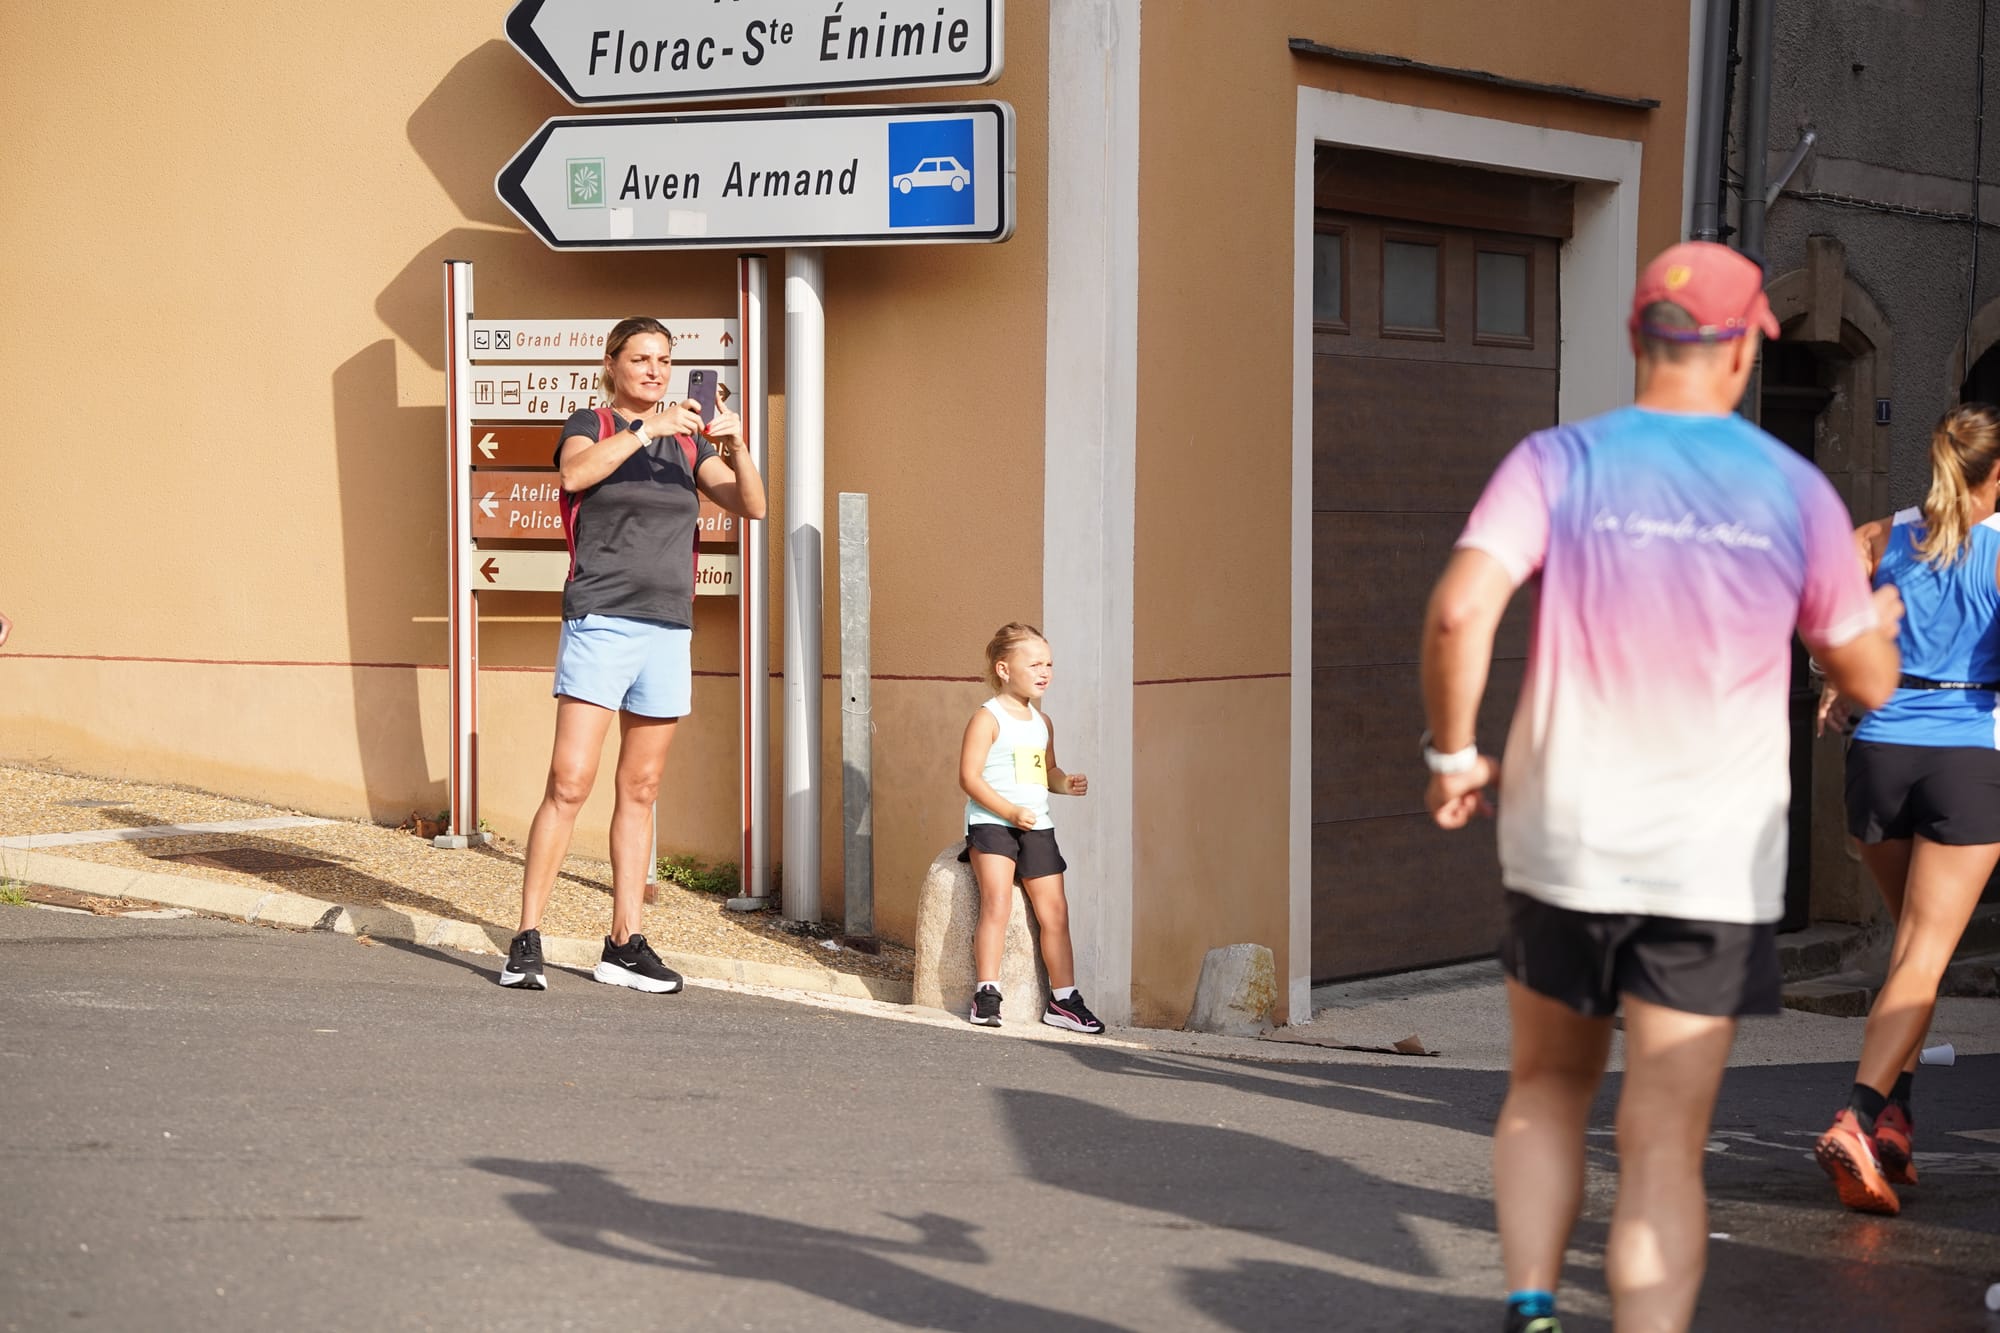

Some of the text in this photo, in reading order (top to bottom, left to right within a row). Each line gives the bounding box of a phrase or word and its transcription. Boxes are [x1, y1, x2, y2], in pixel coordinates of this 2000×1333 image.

[819, 1, 969, 62] Énimie
[619, 157, 859, 201] Aven Armand
[516, 331, 609, 348] Grand Hôte
[527, 371, 602, 391] Les Tab
[527, 395, 549, 414] de
[559, 395, 577, 414] la
[509, 483, 561, 502] Atelie
[509, 510, 733, 531] Police pale
[695, 566, 733, 585] ation
[1033, 754, 1042, 769] 2
